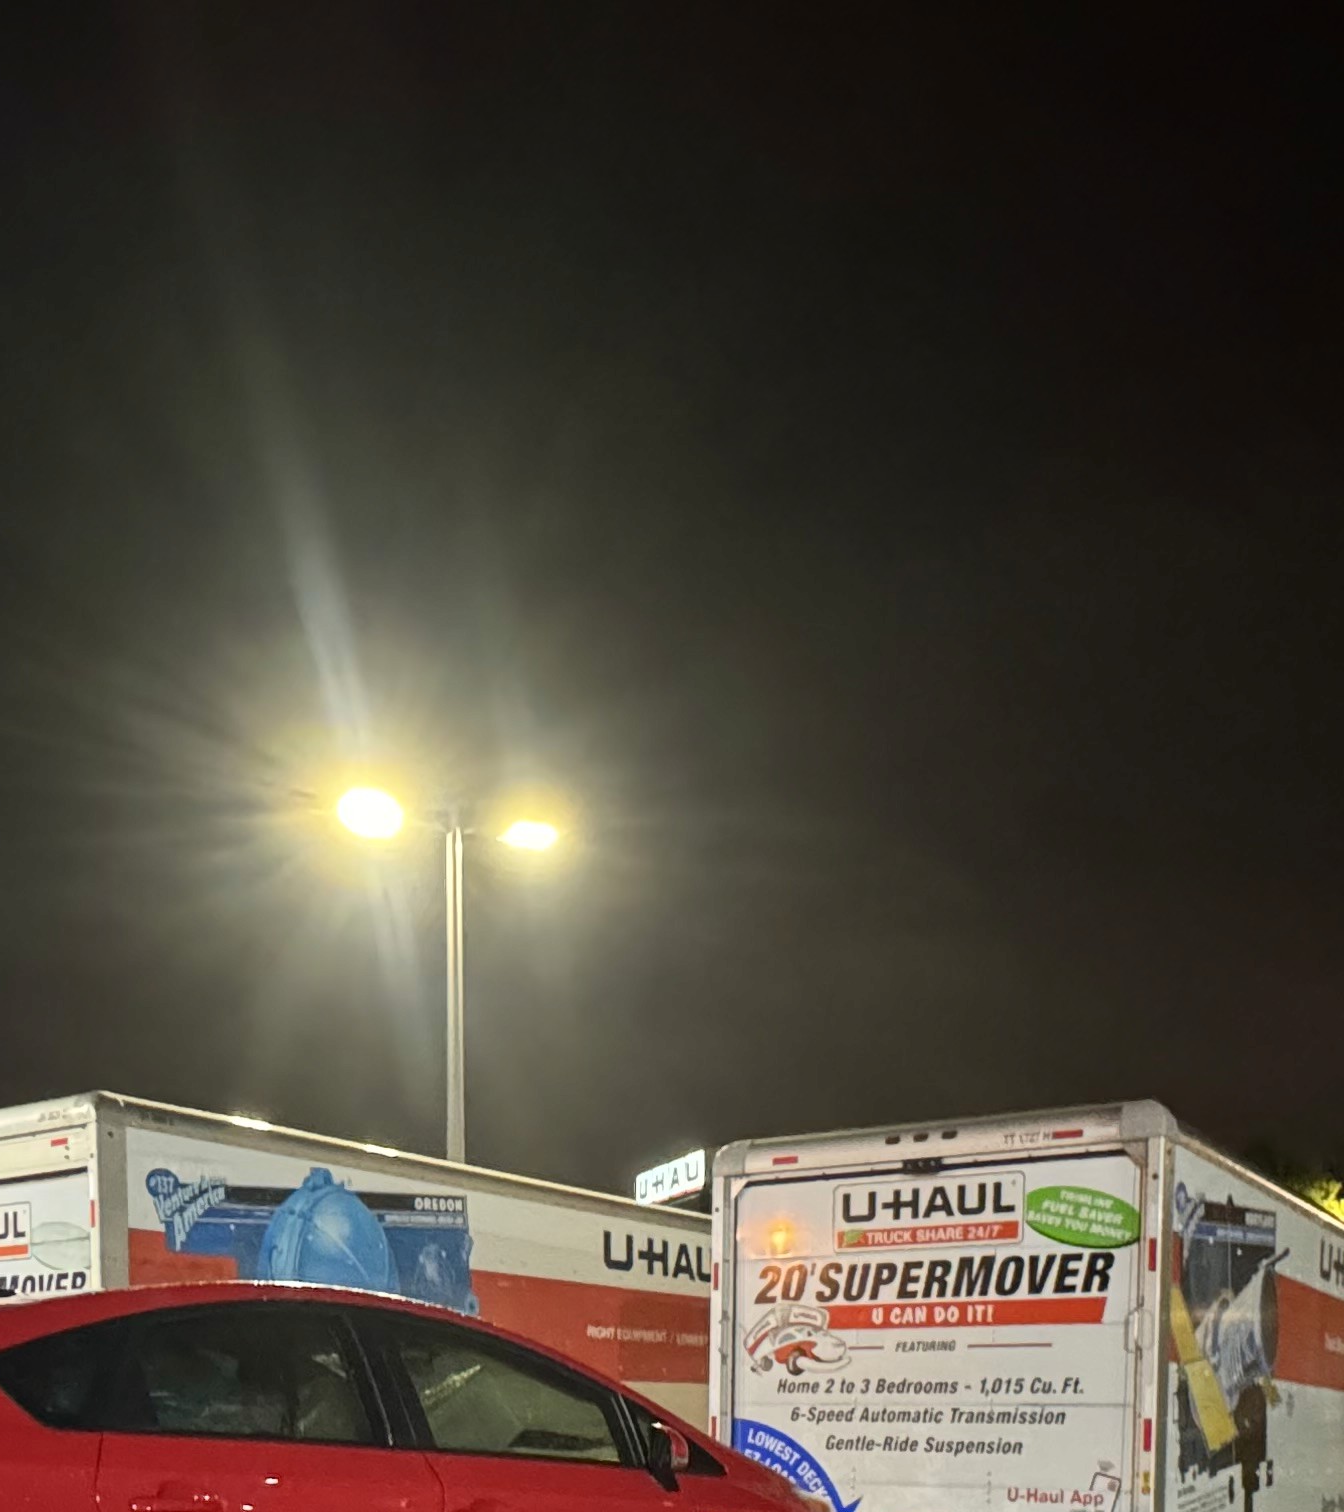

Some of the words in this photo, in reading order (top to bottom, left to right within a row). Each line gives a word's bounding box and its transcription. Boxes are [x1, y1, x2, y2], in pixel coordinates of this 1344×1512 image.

[413, 1196, 464, 1212] OREGON
[842, 1180, 1016, 1223] U-HAUL
[1041, 1199, 1075, 1216] FUEL
[174, 1186, 226, 1251] America
[866, 1228, 914, 1245] TRUCK
[916, 1226, 964, 1243] SHARE
[967, 1223, 1000, 1239] 24/7
[816, 1251, 1116, 1302] SUPERMOVER
[871, 1306, 884, 1323] U
[889, 1304, 927, 1323] CAN
[934, 1304, 961, 1323] DO
[966, 1303, 995, 1322] IT!
[894, 1339, 956, 1353] FEATURING
[776, 1377, 820, 1394] Home
[825, 1378, 836, 1394] 2
[840, 1378, 856, 1393] to
[860, 1378, 870, 1394] 3
[875, 1377, 958, 1394] Bedrooms
[978, 1377, 1025, 1396] 1,015
[1030, 1377, 1058, 1394] Cu.
[1061, 1377, 1085, 1394] Ft.
[790, 1406, 854, 1426] 6-Speed
[859, 1407, 944, 1424] Automatic
[949, 1407, 1067, 1425] Transmission
[825, 1434, 919, 1452] Gentle-Ride
[923, 1436, 1024, 1457] Suspension
[747, 1427, 801, 1466] LOWEST
[795, 1461, 829, 1498] DECK
[1007, 1487, 1064, 1504] U-Haul
[1070, 1489, 1105, 1507] App
